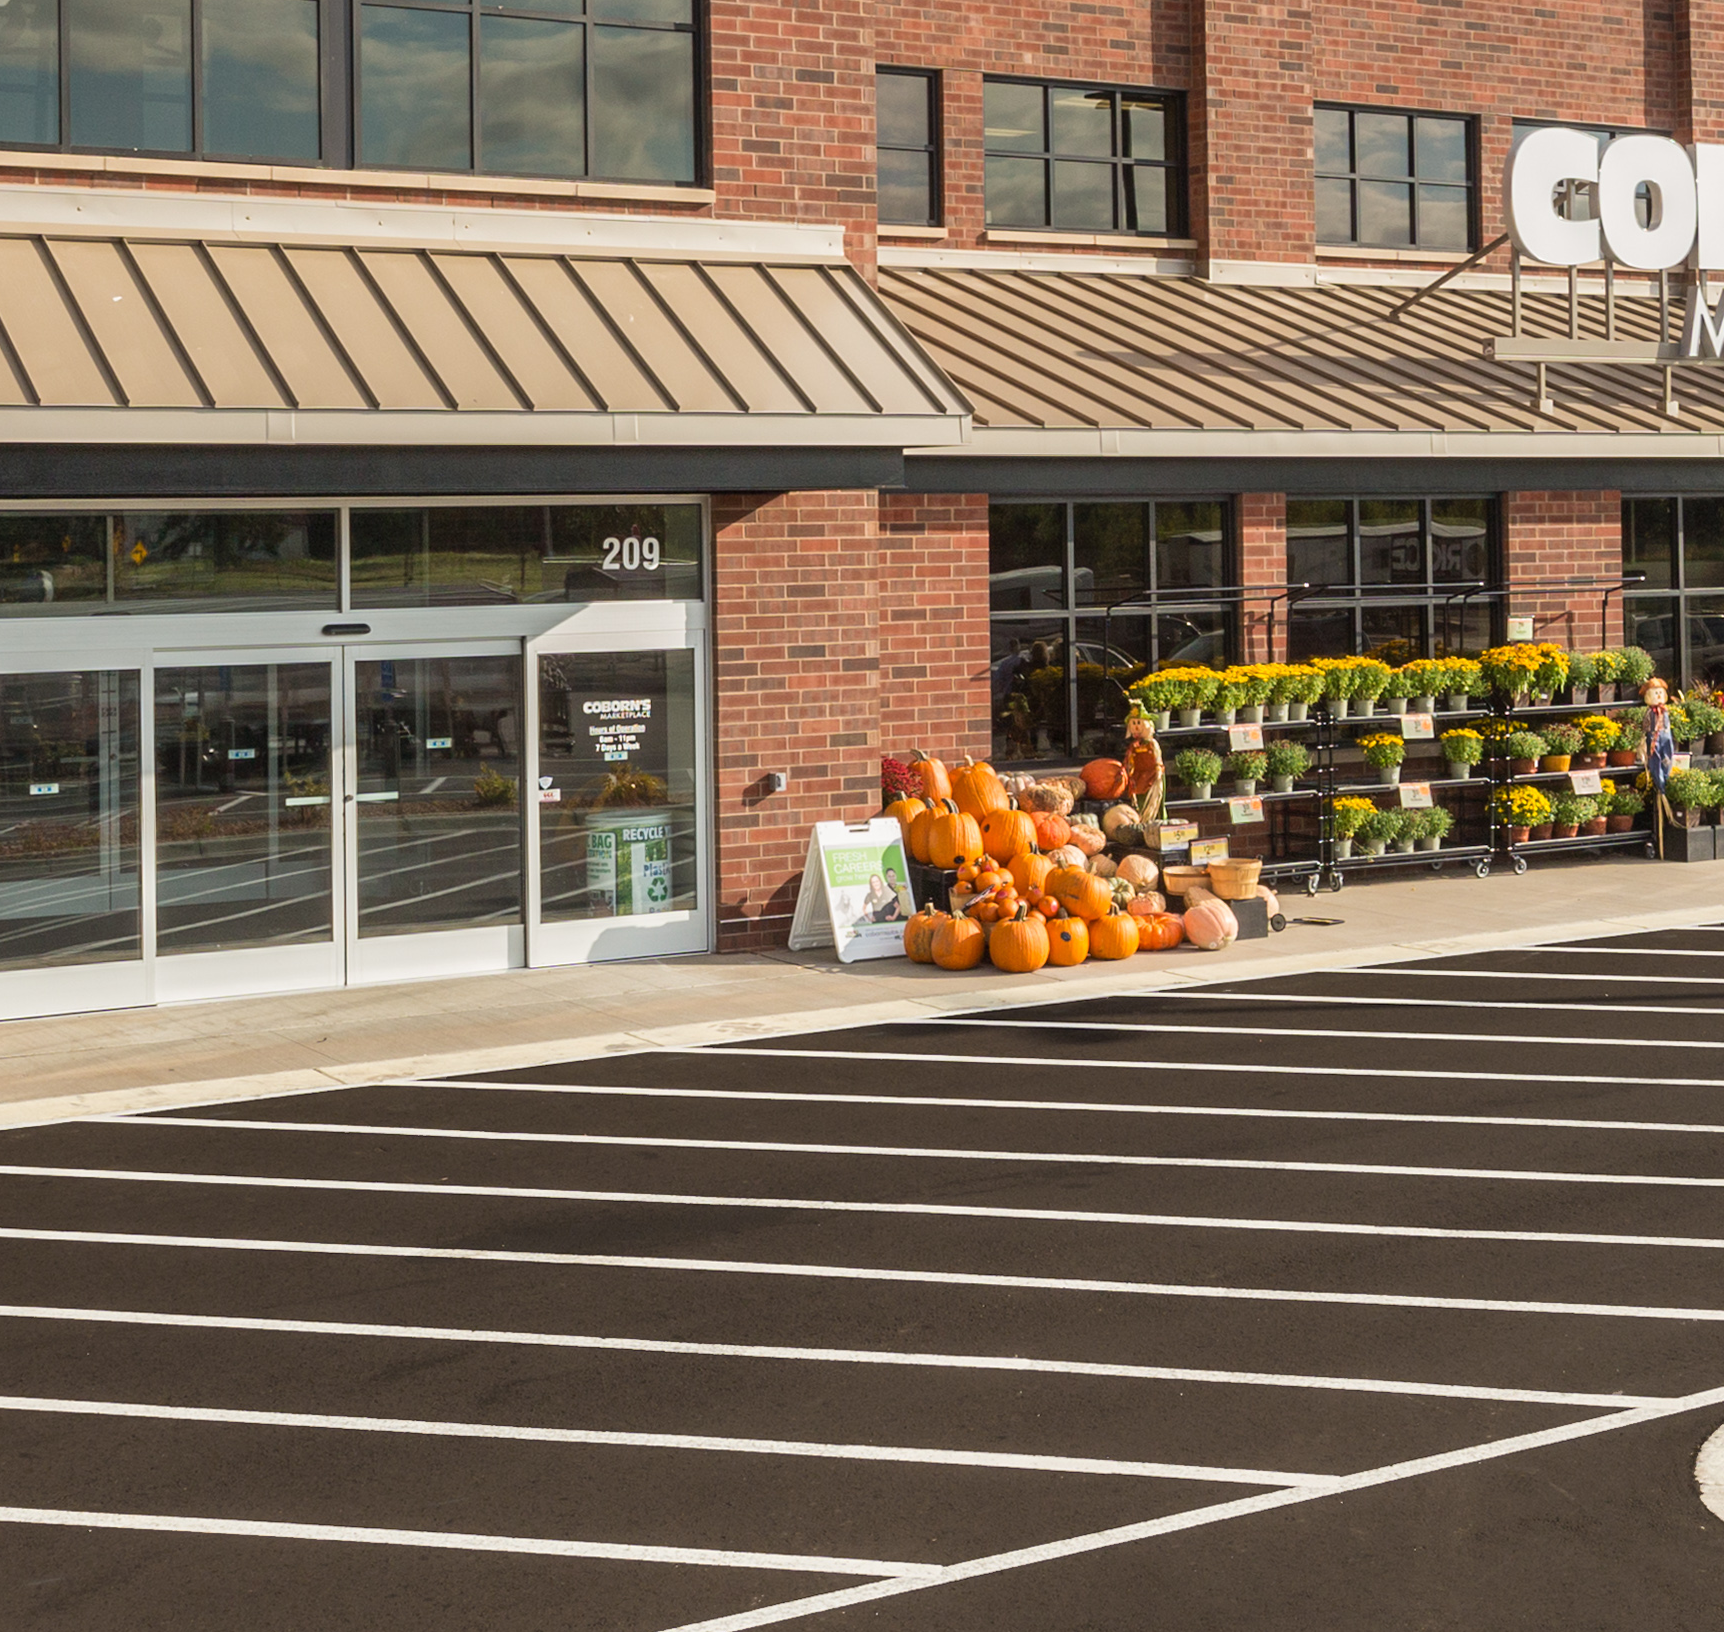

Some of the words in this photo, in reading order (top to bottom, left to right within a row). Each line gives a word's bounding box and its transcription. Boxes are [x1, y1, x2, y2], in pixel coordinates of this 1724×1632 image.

[602, 536, 660, 571] 209
[583, 698, 652, 715] COBORN'S
[600, 710, 651, 720] MARKETPLACE
[591, 834, 612, 849] BAG
[622, 826, 664, 842] RECYCLE
[833, 852, 868, 863] FRESH
[834, 860, 883, 874] CAREERS
